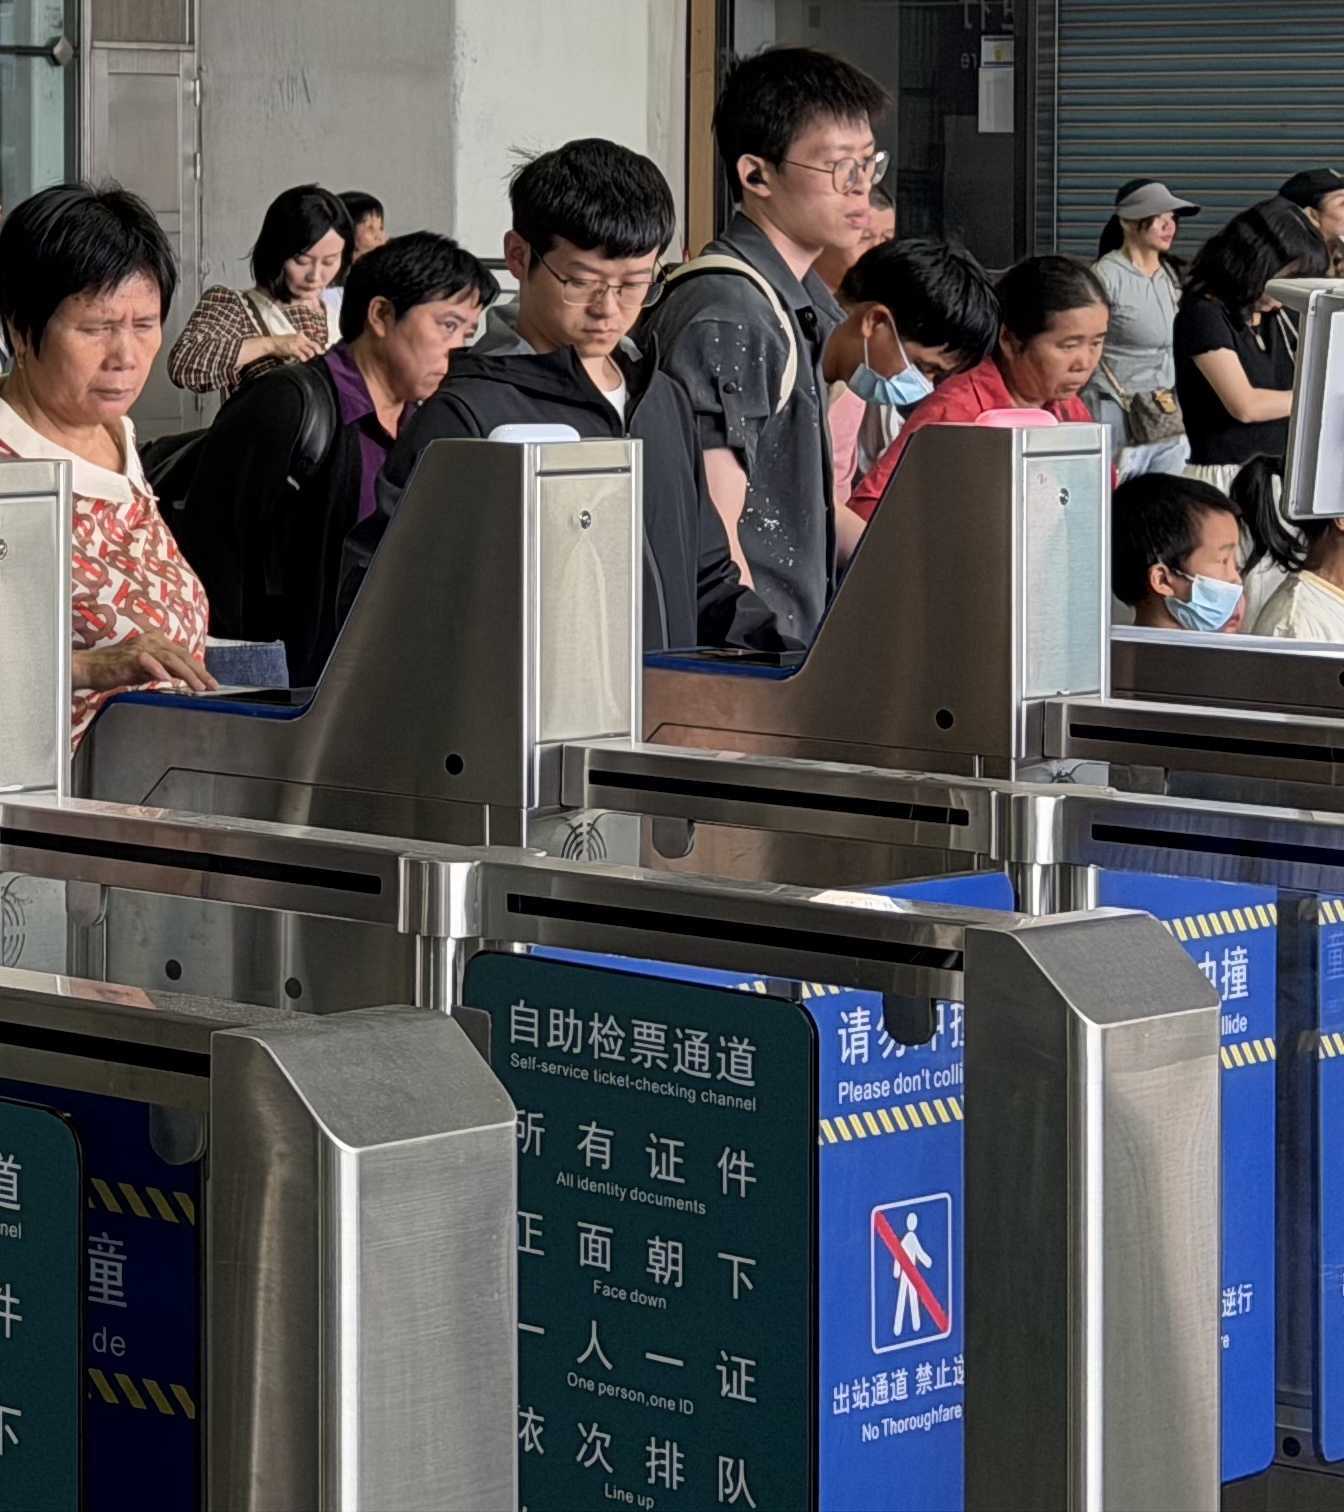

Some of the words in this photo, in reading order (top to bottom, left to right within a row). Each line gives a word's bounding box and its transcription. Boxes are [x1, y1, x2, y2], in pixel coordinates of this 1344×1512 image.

[511, 1000, 756, 1091] 自助检票通道
[511, 1053, 589, 1080] Self-service
[593, 1067, 697, 1104] ticket-checking
[701, 1089, 756, 1111] channel
[838, 1080, 890, 1105] Please
[893, 1068, 931, 1095] don't
[516, 1110, 757, 1198] 所有证件
[556, 1172, 573, 1187] All
[578, 1176, 627, 1201] identity
[630, 1187, 706, 1214] documents
[517, 1210, 757, 1300] 正面朝下
[594, 1280, 627, 1300] Face
[630, 1289, 666, 1309] down
[518, 1320, 757, 1404] 一人一证
[567, 1372, 594, 1391] One
[679, 1398, 693, 1414] ID
[833, 1367, 909, 1415] 出站通道
[862, 1422, 880, 1443] No
[881, 1403, 963, 1437] Thoroughfare
[519, 1405, 757, 1509] 依次排队
[605, 1483, 633, 1503] Line
[637, 1489, 655, 1510] up
